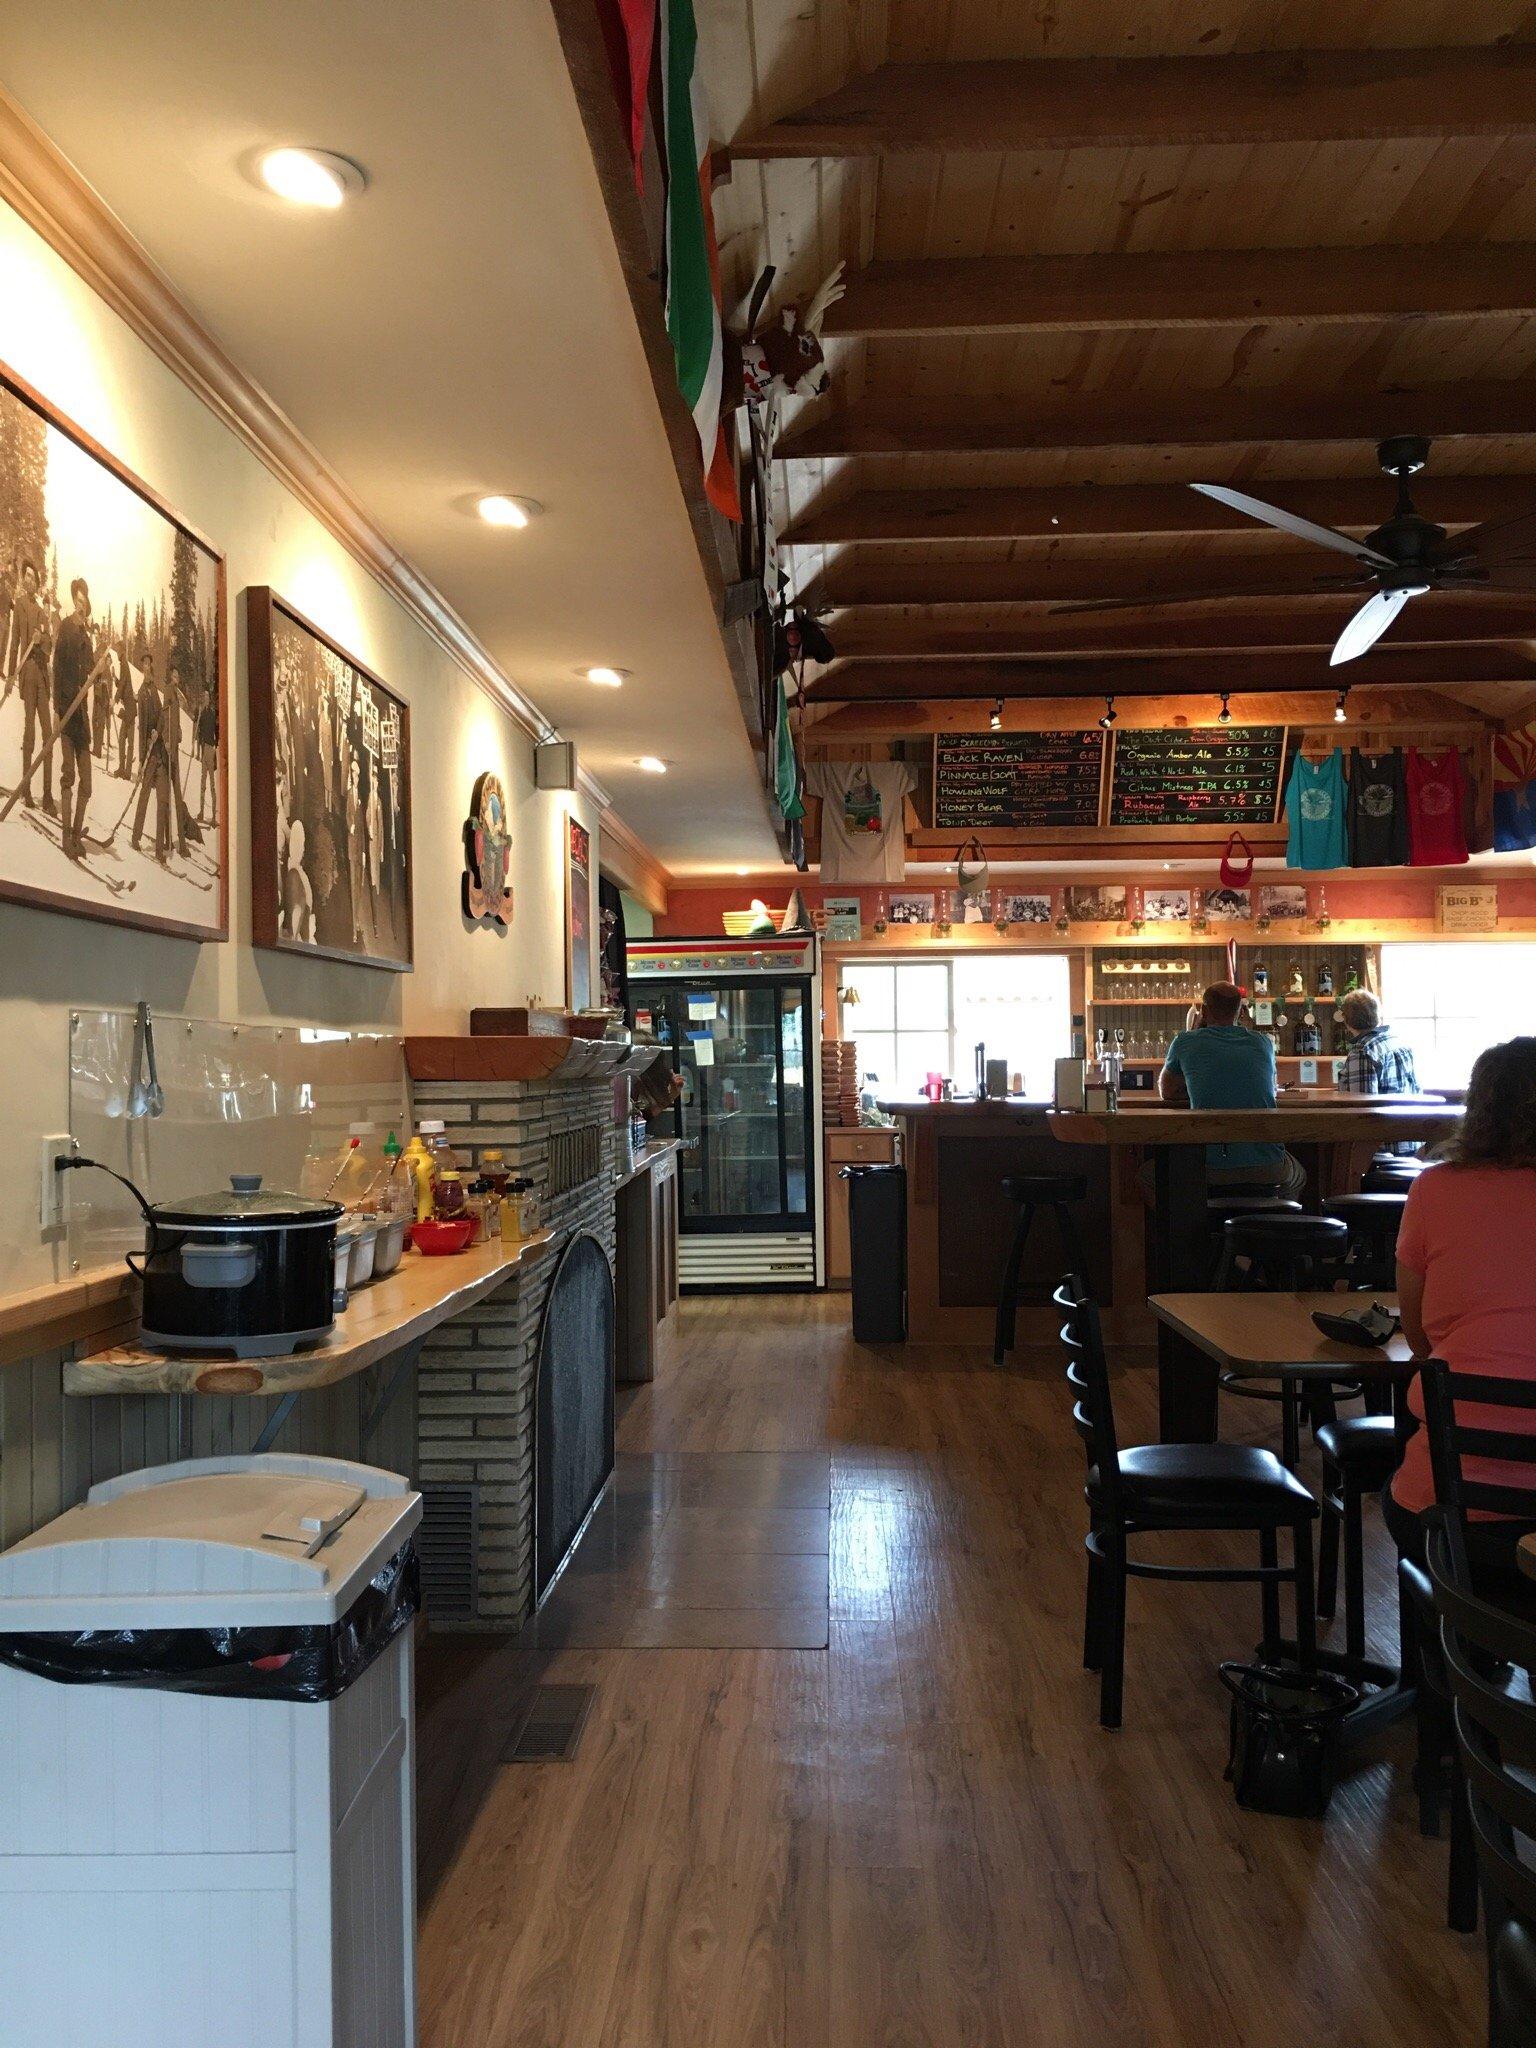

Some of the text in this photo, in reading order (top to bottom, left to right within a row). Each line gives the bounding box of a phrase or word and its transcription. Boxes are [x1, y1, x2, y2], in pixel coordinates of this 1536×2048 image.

[943, 754, 979, 763] BLACK
[984, 752, 1024, 763] RAVEN
[1127, 750, 1161, 761] Organic
[1166, 748, 1193, 759] Amber
[1195, 749, 1212, 759] Ale
[1225, 746, 1250, 757] 5.5%
[940, 770, 990, 780] PINNACLE
[990, 769, 1018, 780] GOAT
[941, 786, 982, 796] HOWLING
[983, 786, 1008, 795] WOLF
[1128, 783, 1156, 793] Citrus
[1198, 781, 1217, 791] IPA
[1178, 793, 1211, 803] Raspberry
[1218, 793, 1272, 806] 5.7% $5
[940, 802, 975, 812] HONEY
[977, 801, 1004, 812] BEAR
[1176, 813, 1198, 823] Porter
[1446, 896, 1468, 906] BIG
